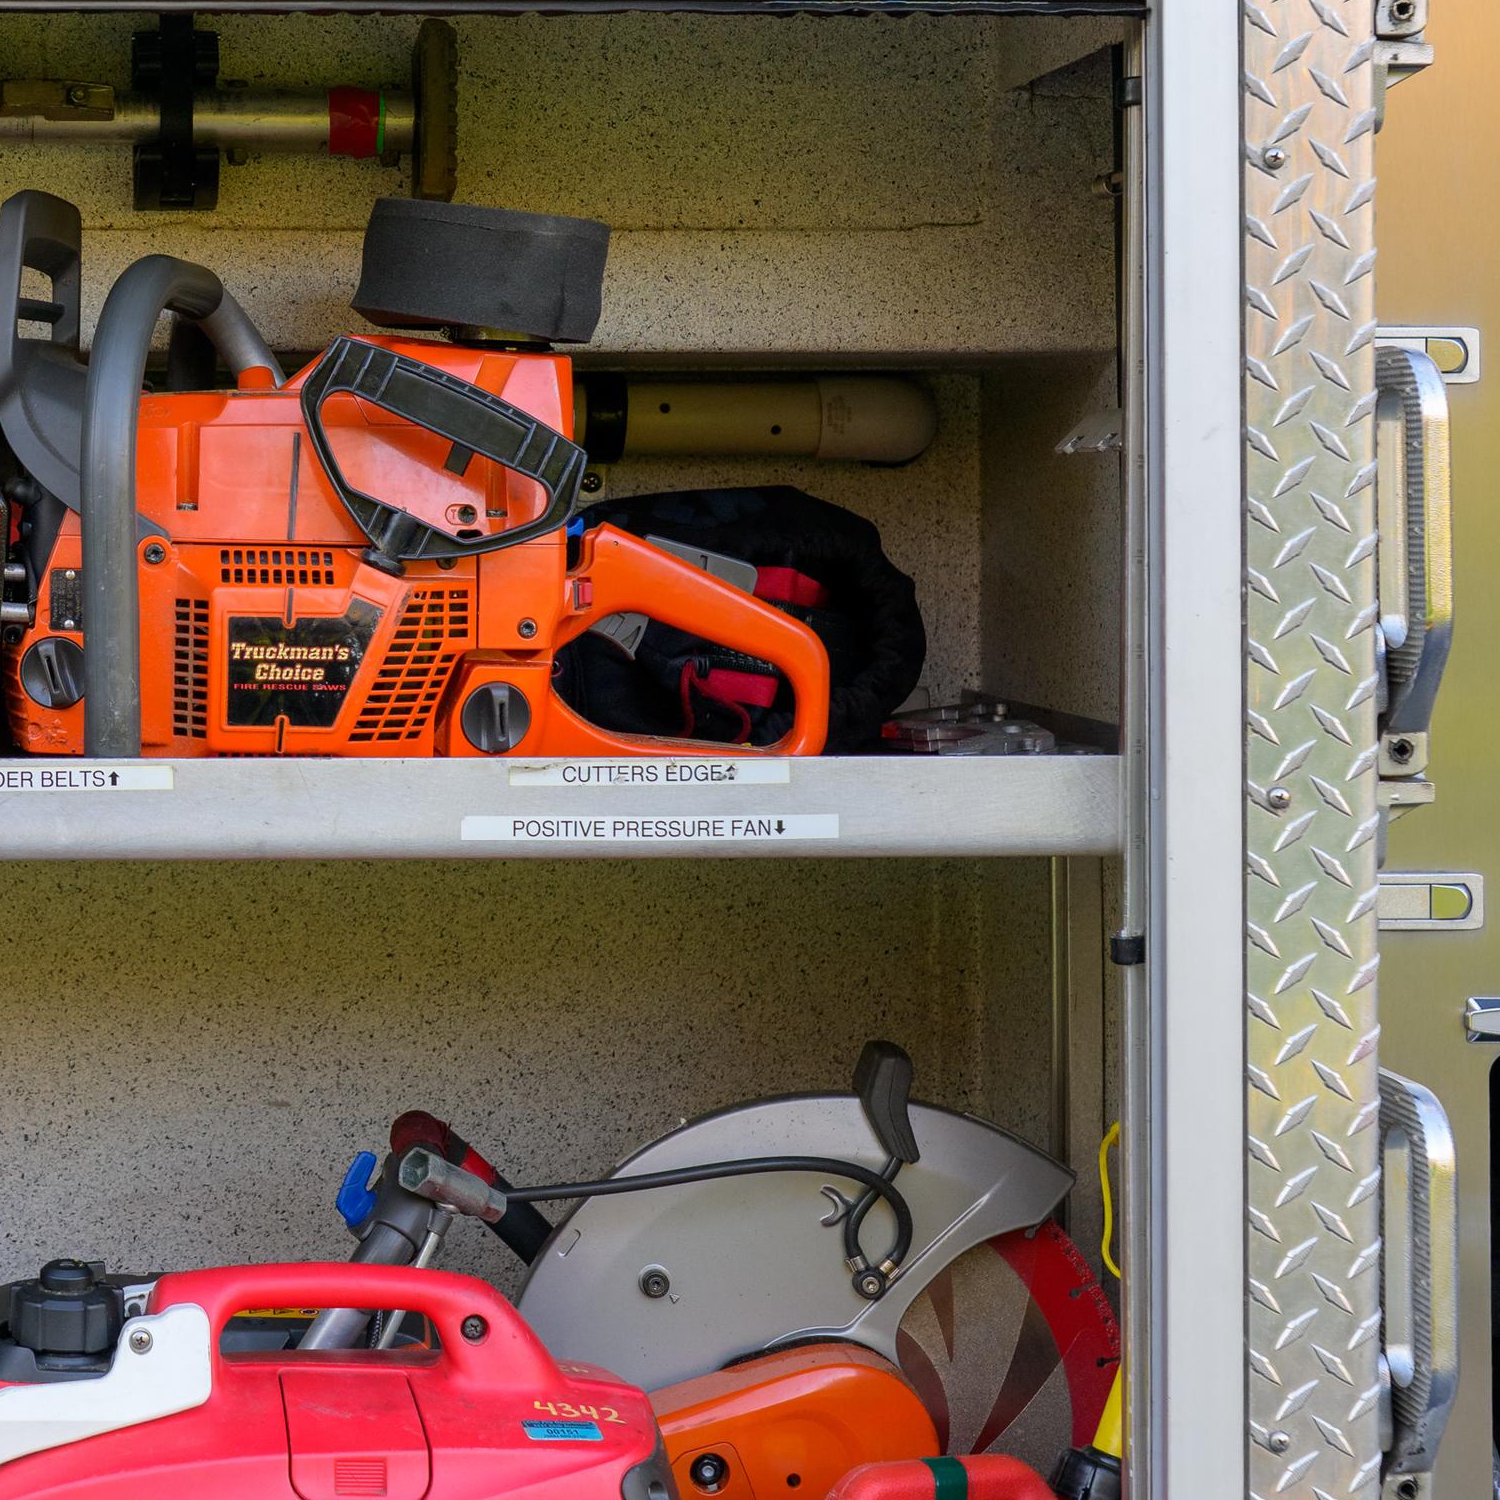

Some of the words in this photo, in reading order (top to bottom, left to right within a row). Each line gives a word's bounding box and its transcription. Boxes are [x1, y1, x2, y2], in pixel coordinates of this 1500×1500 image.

[231, 642, 349, 661] Truckman's
[255, 663, 325, 681] Choice
[41, 771, 105, 788] BELTS
[562, 765, 659, 783] CUTTERS
[666, 764, 722, 782] EDGE
[513, 820, 606, 838] POSITIVE
[613, 820, 725, 838] PRESSURE
[731, 820, 771, 837] FAN
[534, 1401, 627, 1424] 4342
